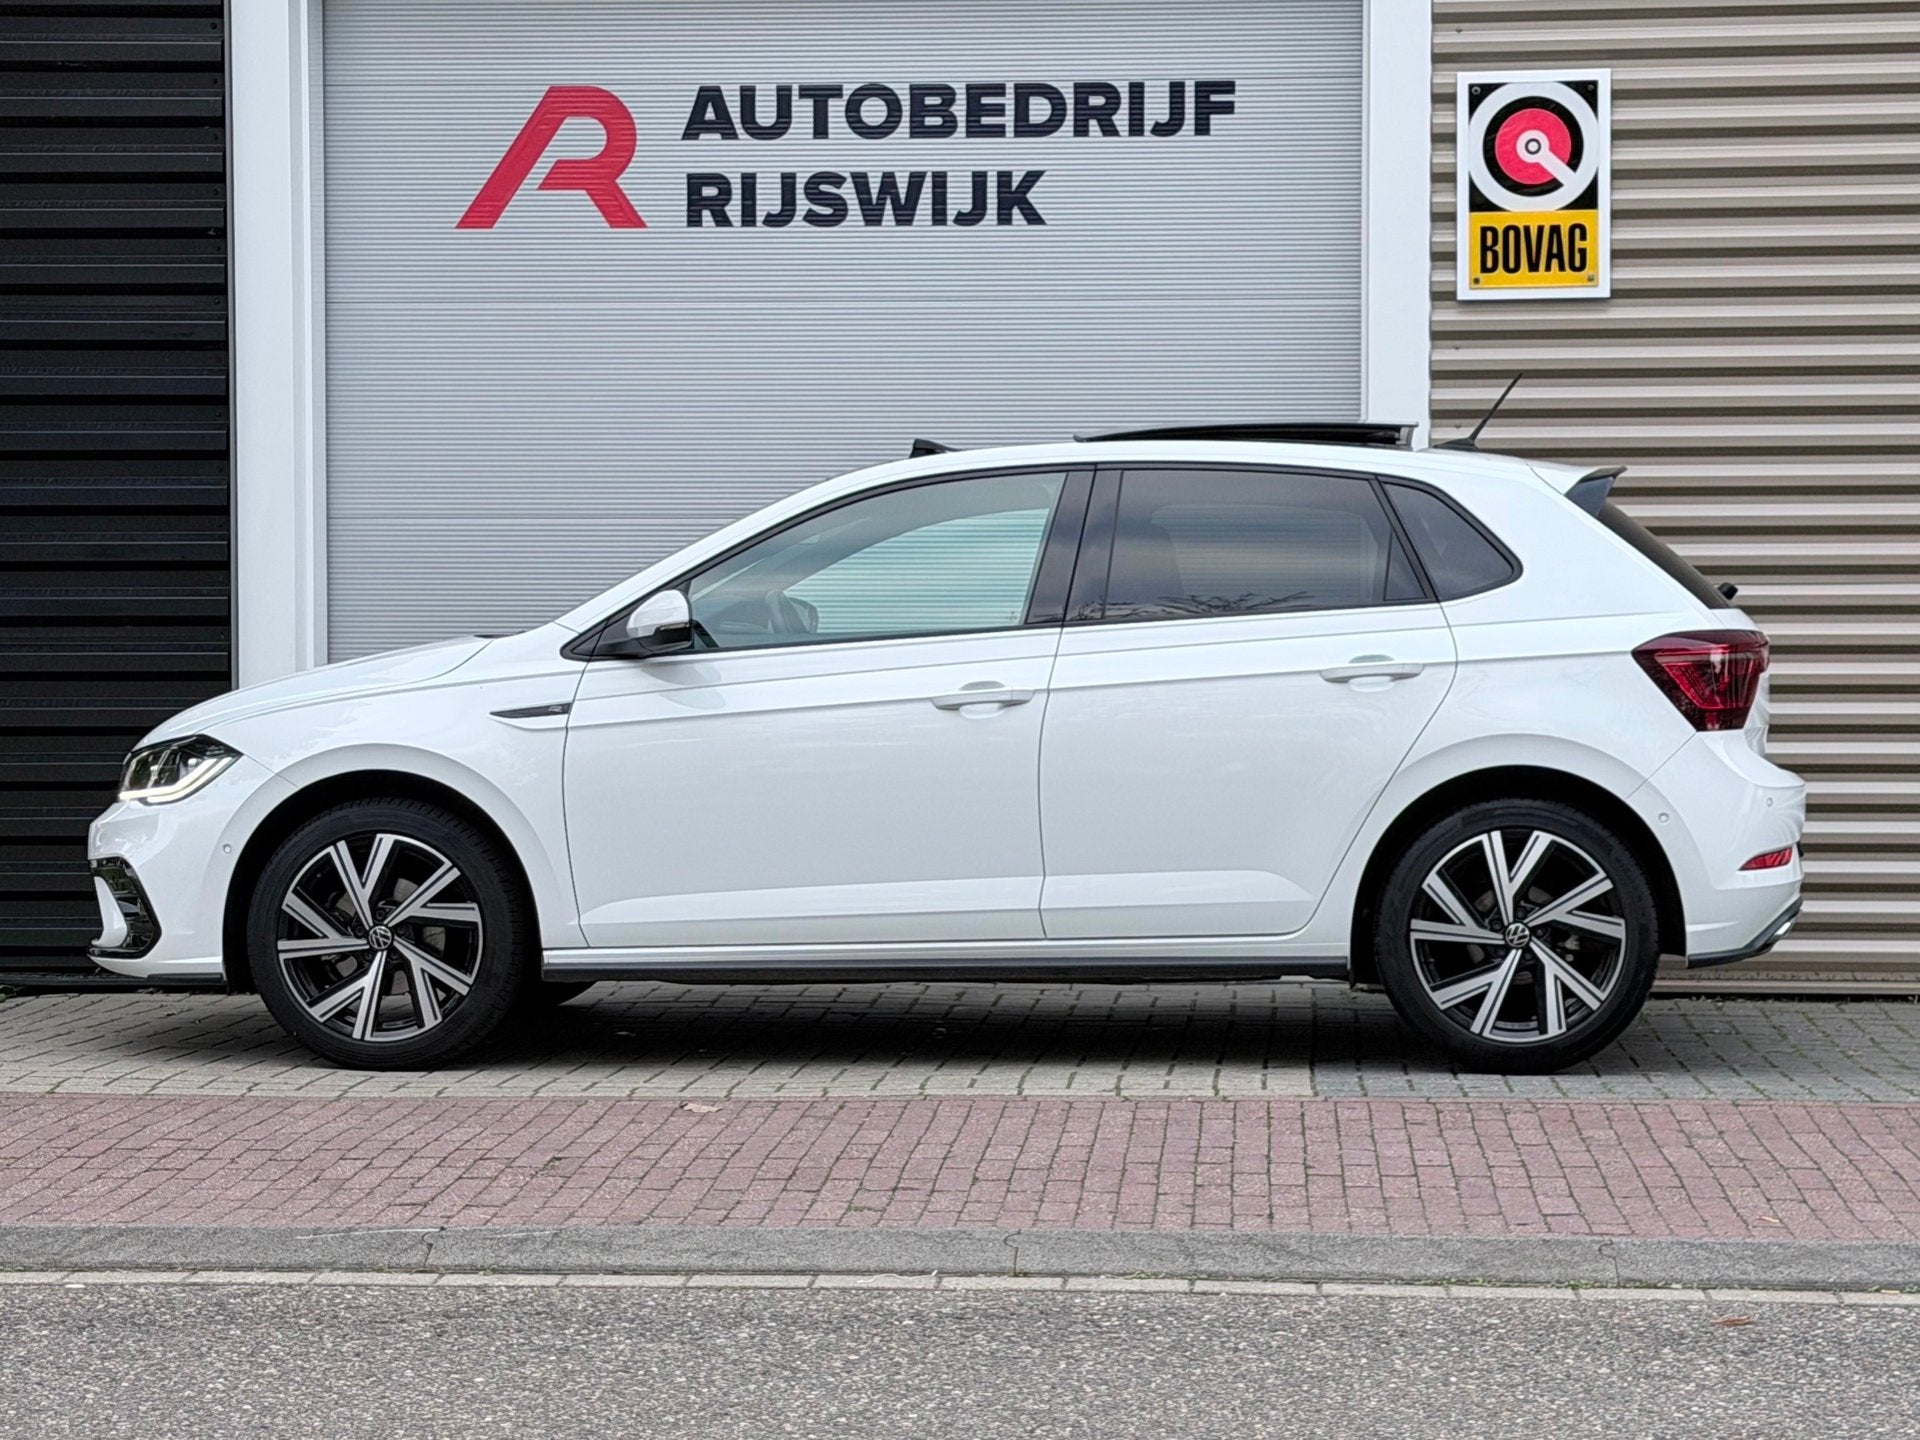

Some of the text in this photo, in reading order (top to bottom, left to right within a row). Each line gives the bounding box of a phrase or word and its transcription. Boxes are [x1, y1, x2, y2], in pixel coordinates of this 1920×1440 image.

[681, 81, 1236, 140] AUTOBEDRIJF
[687, 171, 1046, 228] RIJSWIJK
[1480, 223, 1587, 274] BOVAG
